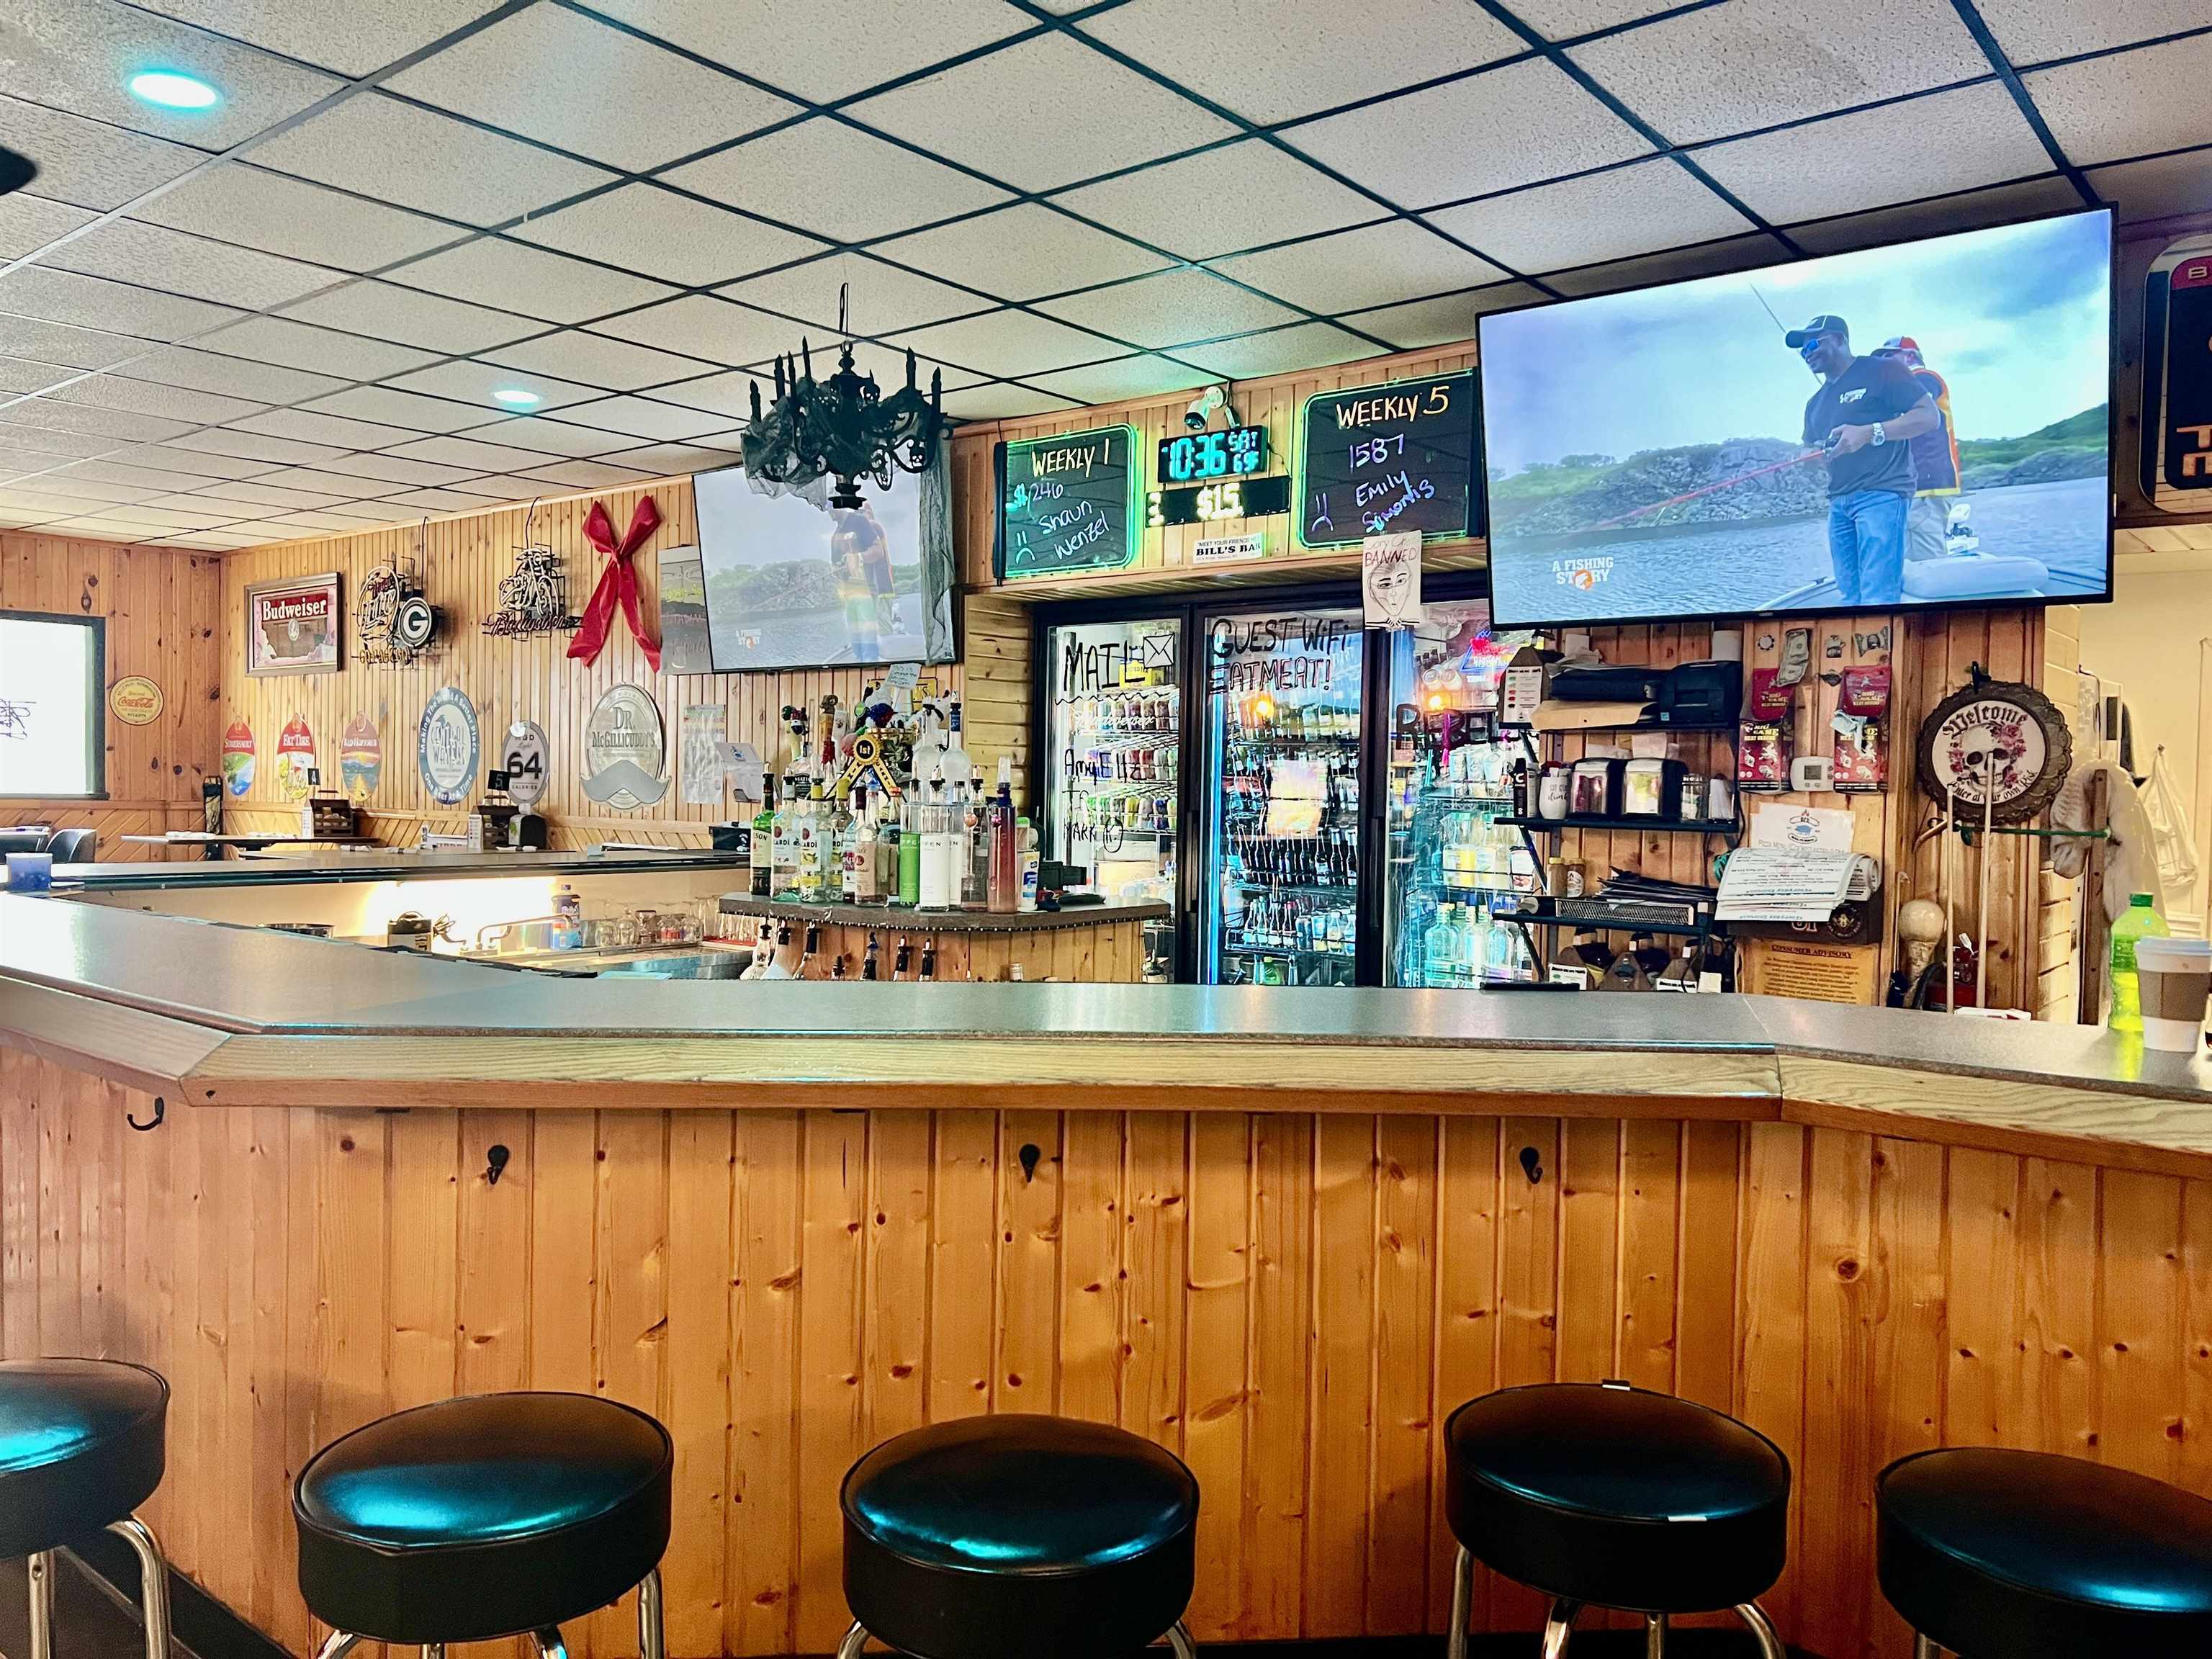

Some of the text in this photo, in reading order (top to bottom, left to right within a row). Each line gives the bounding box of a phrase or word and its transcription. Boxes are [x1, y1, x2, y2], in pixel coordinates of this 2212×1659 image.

[1336, 386, 1449, 427] WEEKLY 5
[1032, 438, 1110, 478] WEEKLY 1
[1169, 433, 1226, 480] 10:36
[1228, 430, 1258, 452] SAT
[1349, 433, 1404, 474] 1587
[1039, 500, 1092, 534] Shaun
[1197, 482, 1244, 521] $15
[1196, 546, 1236, 556] BILL'S
[1365, 547, 1417, 567] BANNED
[1552, 557, 1614, 572] A FISHING
[263, 598, 327, 621] Budweiser
[403, 605, 431, 639] G
[1212, 618, 1297, 658] GUEST
[1064, 639, 1146, 692] MAIL
[421, 718, 431, 753] Making
[427, 700, 437, 714] The
[459, 696, 474, 725] Better
[1943, 703, 2028, 739] Welcome
[283, 734, 295, 747] FAT
[507, 752, 543, 780] 64
[425, 773, 435, 791] One
[460, 774, 473, 796] Time
[1771, 945, 1852, 958] CONSUMER ADVISORY
